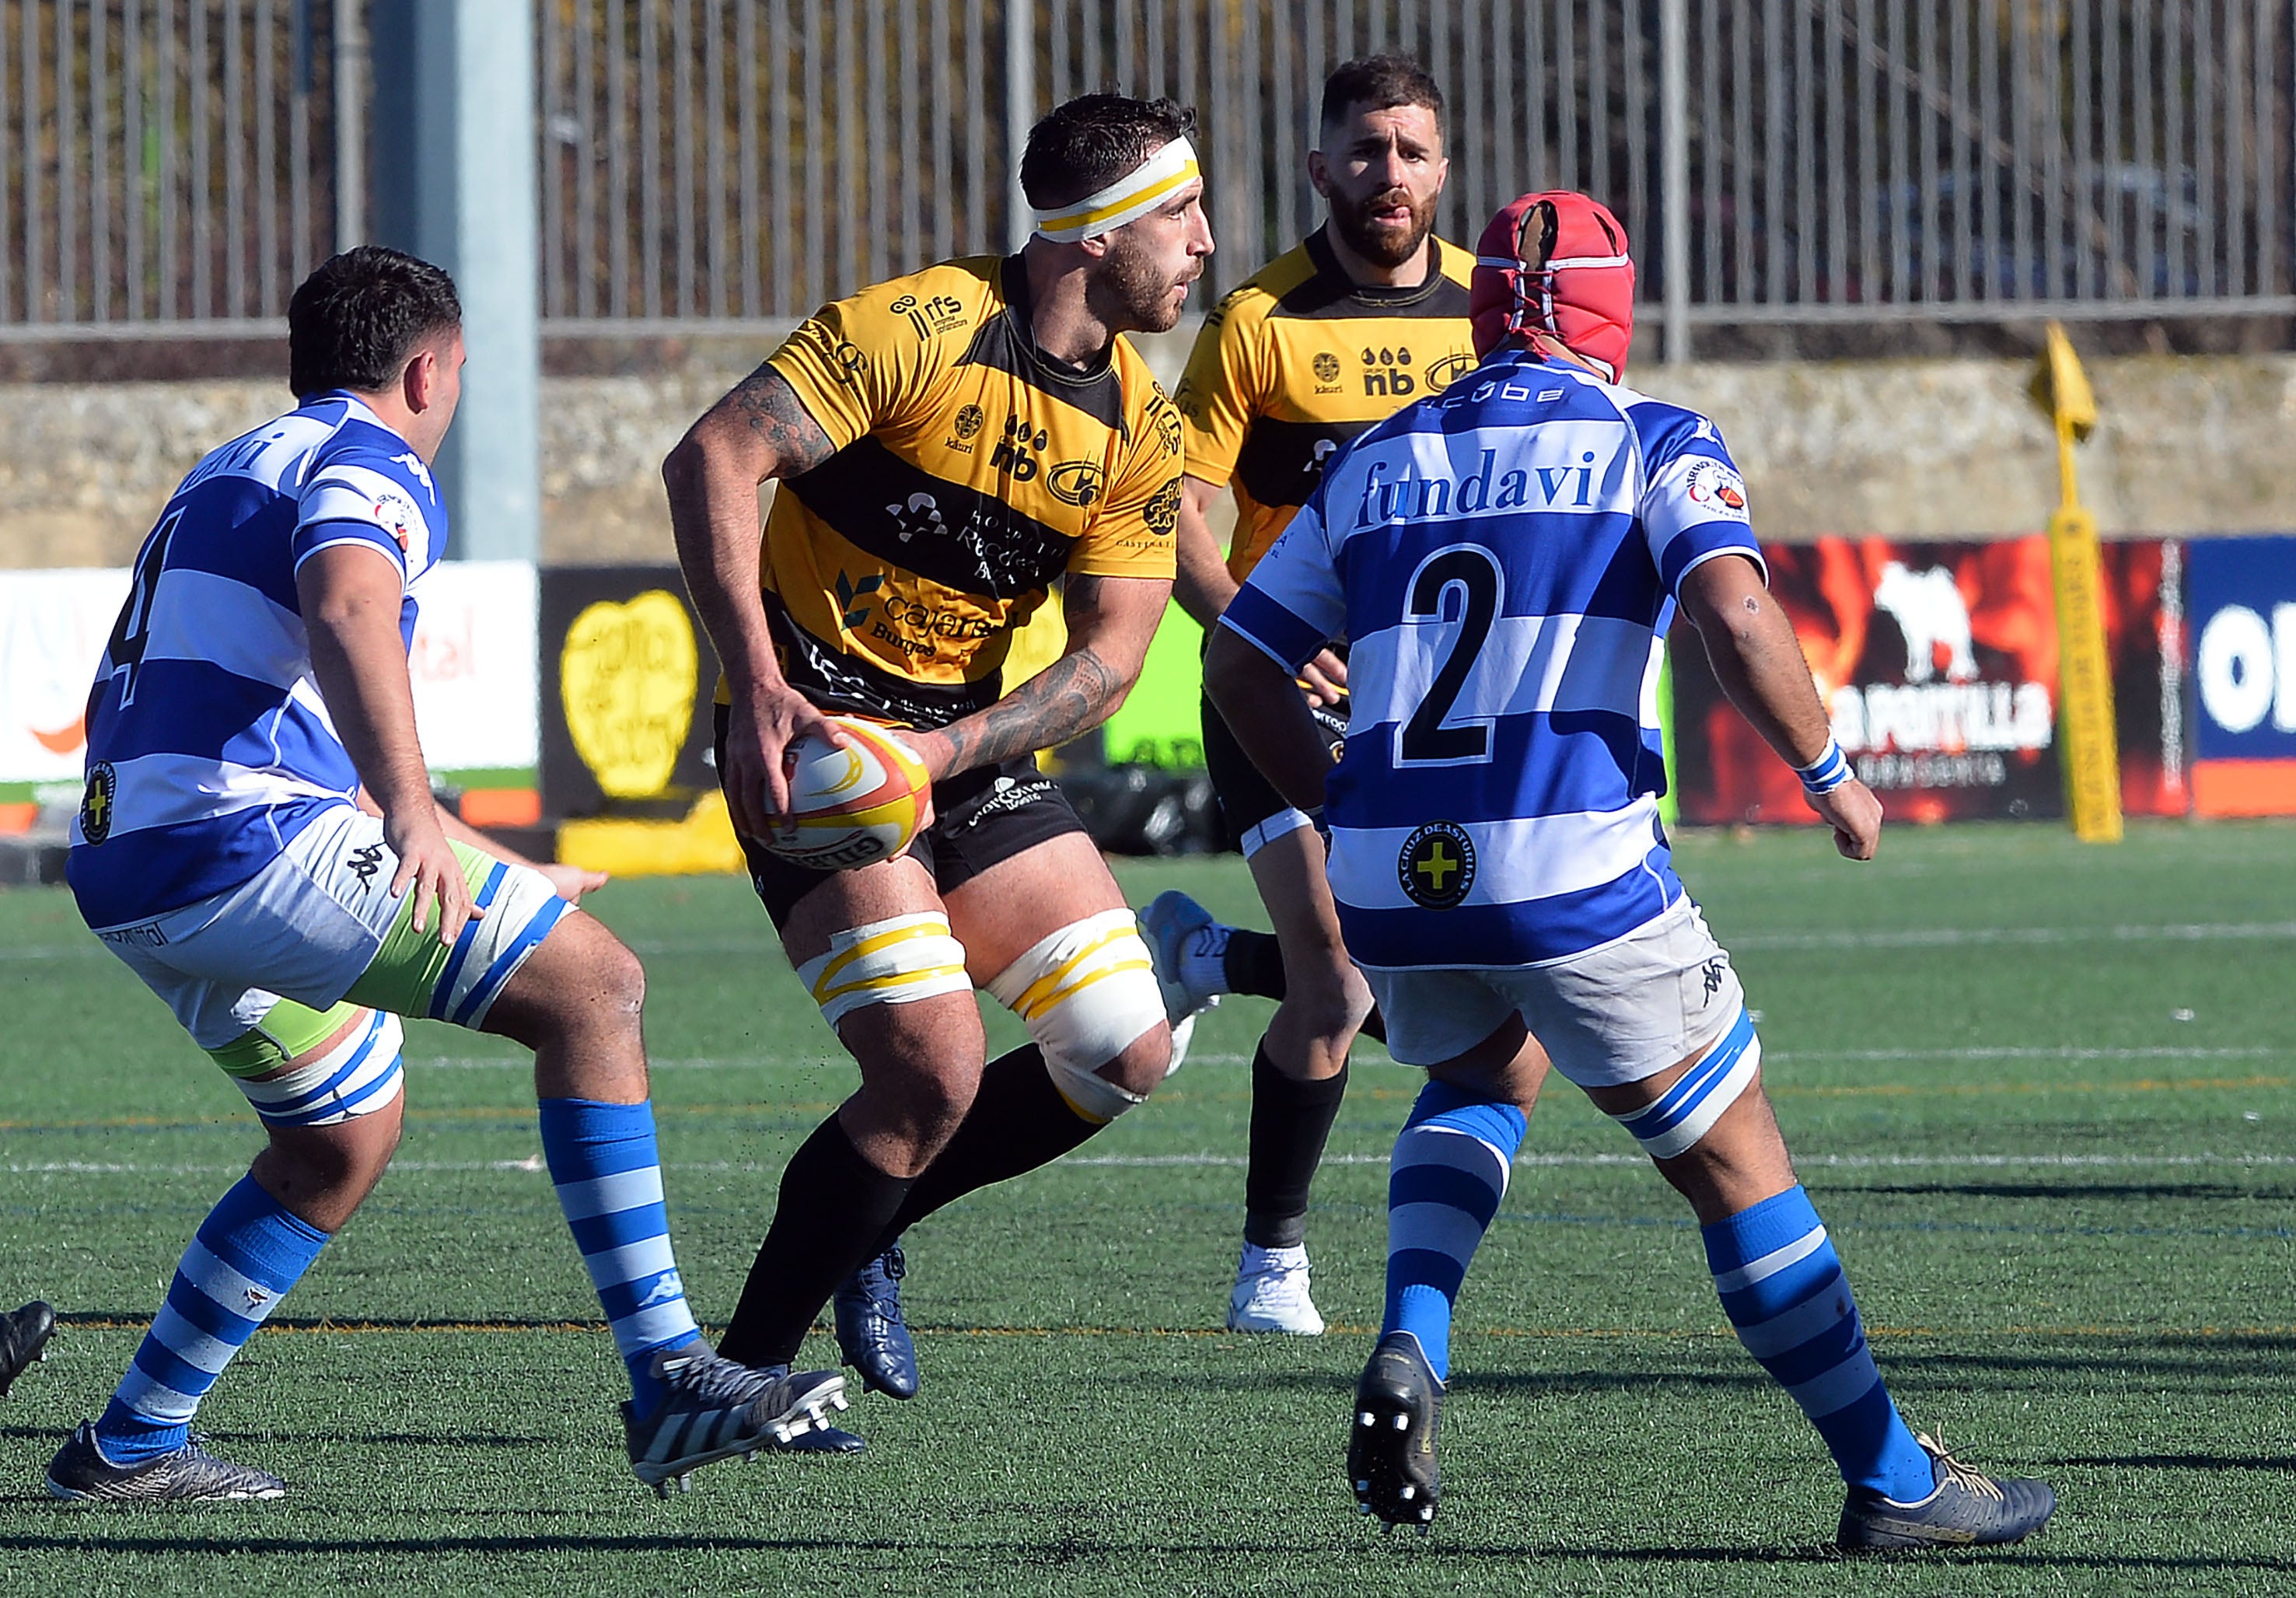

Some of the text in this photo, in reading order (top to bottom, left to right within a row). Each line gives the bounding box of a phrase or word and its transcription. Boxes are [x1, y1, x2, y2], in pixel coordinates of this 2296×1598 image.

[924, 295, 963, 321] rfs
[1364, 368, 1414, 396] nb
[989, 435, 1038, 482] nb
[1354, 447, 1595, 532] fundavi
[870, 622, 938, 658] Burgos
[1393, 542, 1505, 769] 2
[1400, 823, 1474, 892] LA CRUZ DE ASTURIAS
